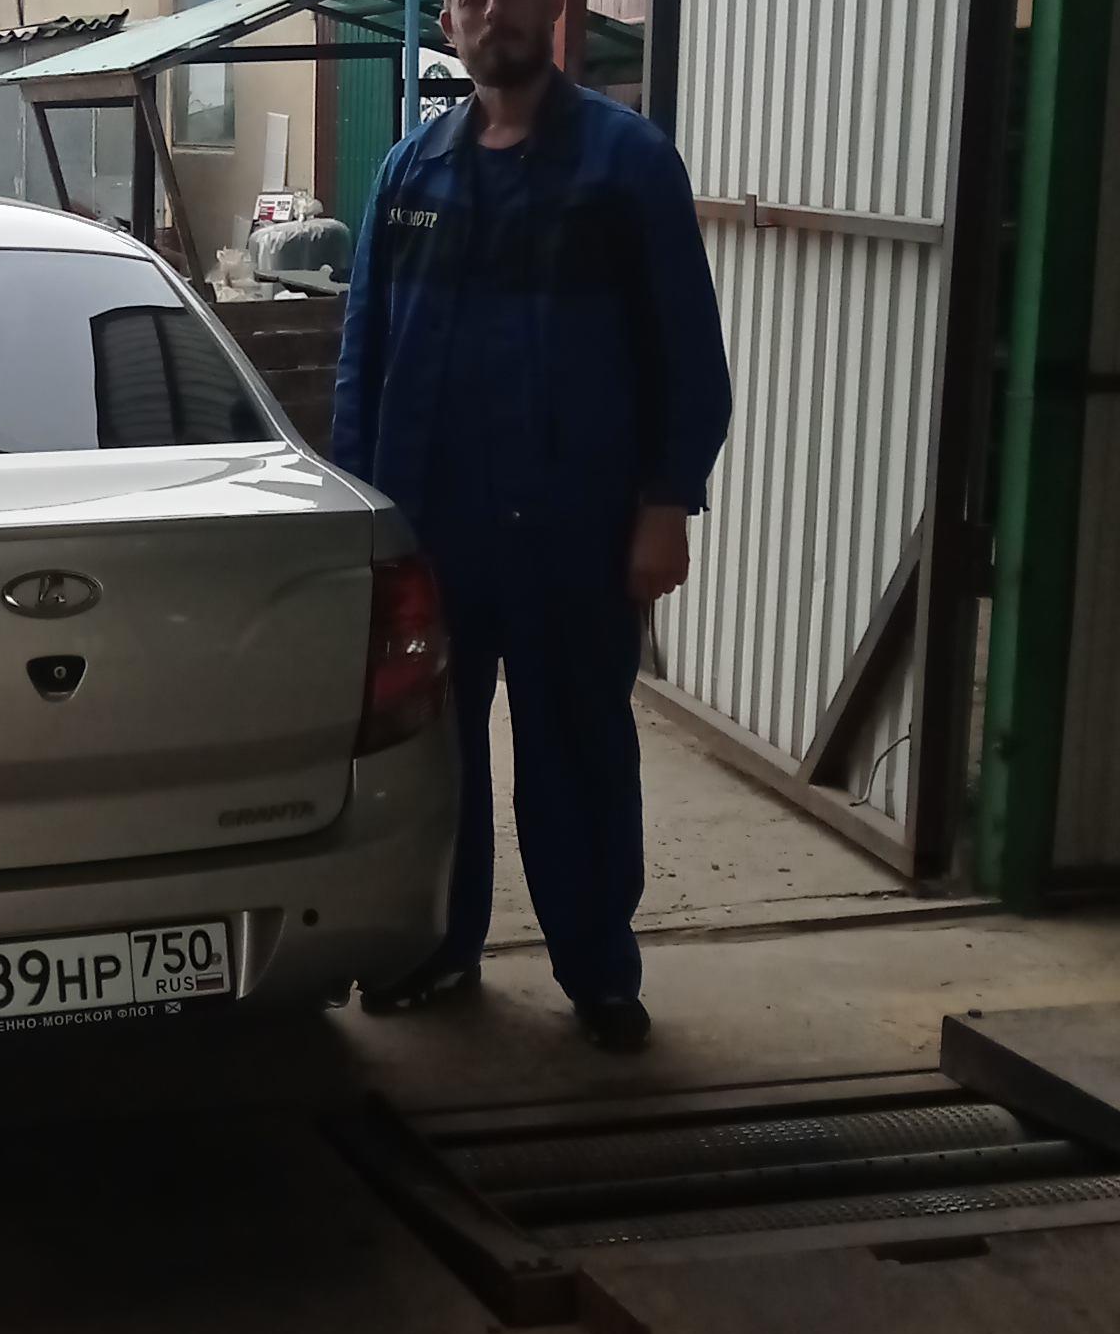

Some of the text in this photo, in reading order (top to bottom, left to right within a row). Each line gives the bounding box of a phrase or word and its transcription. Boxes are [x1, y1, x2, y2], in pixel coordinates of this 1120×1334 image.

[133, 929, 214, 979] 750
[155, 975, 195, 995] RUS
[116, 1004, 156, 1021] ФЛОТ
